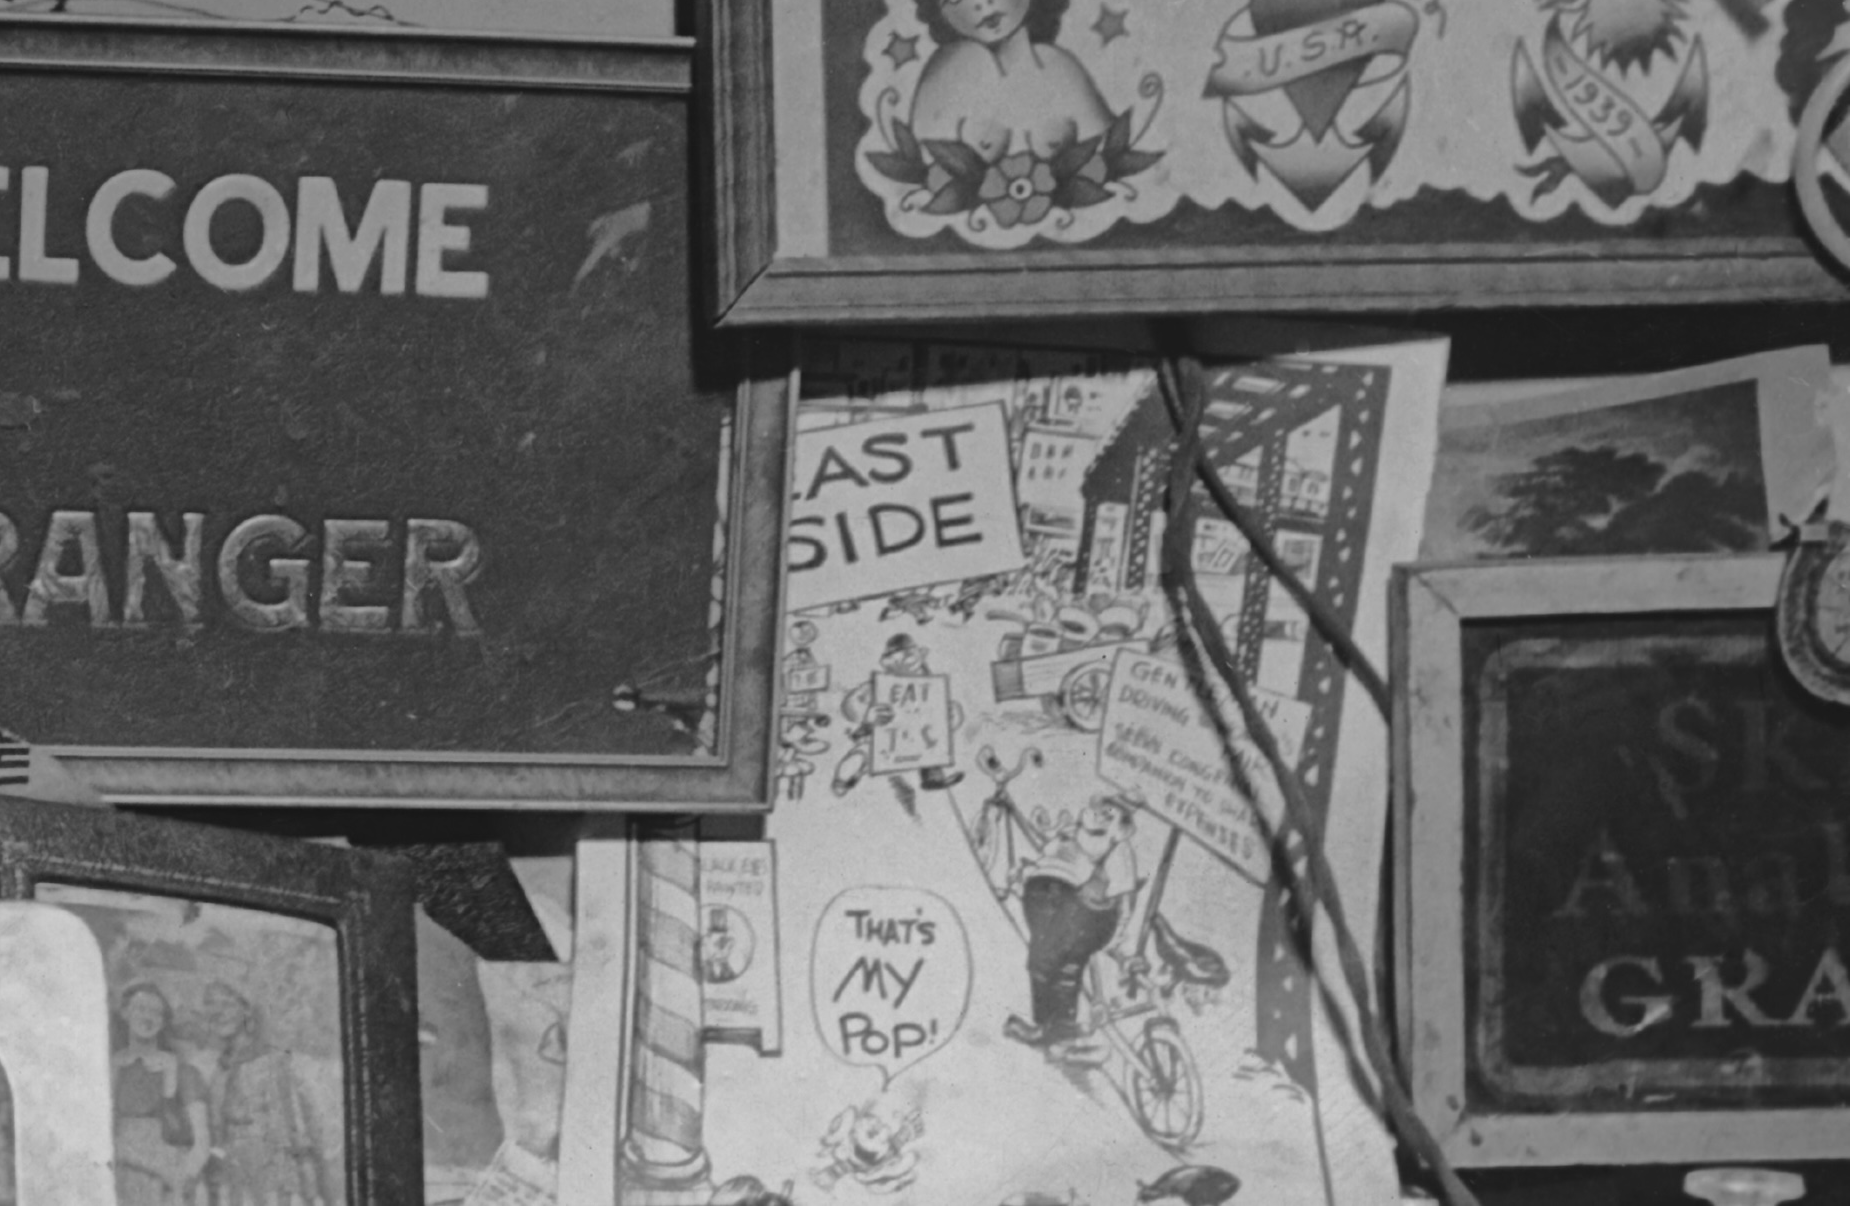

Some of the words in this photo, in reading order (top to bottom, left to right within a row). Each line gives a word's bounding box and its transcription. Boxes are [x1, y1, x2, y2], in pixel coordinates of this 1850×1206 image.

[791, 423, 975, 500] AST
[787, 492, 984, 573] SIDE
[889, 682, 930, 708] EAT
[844, 906, 937, 946] THAT'S
[831, 955, 926, 1010] MY
[1579, 946, 1850, 1037] GRA
[838, 1011, 938, 1059] POP!
